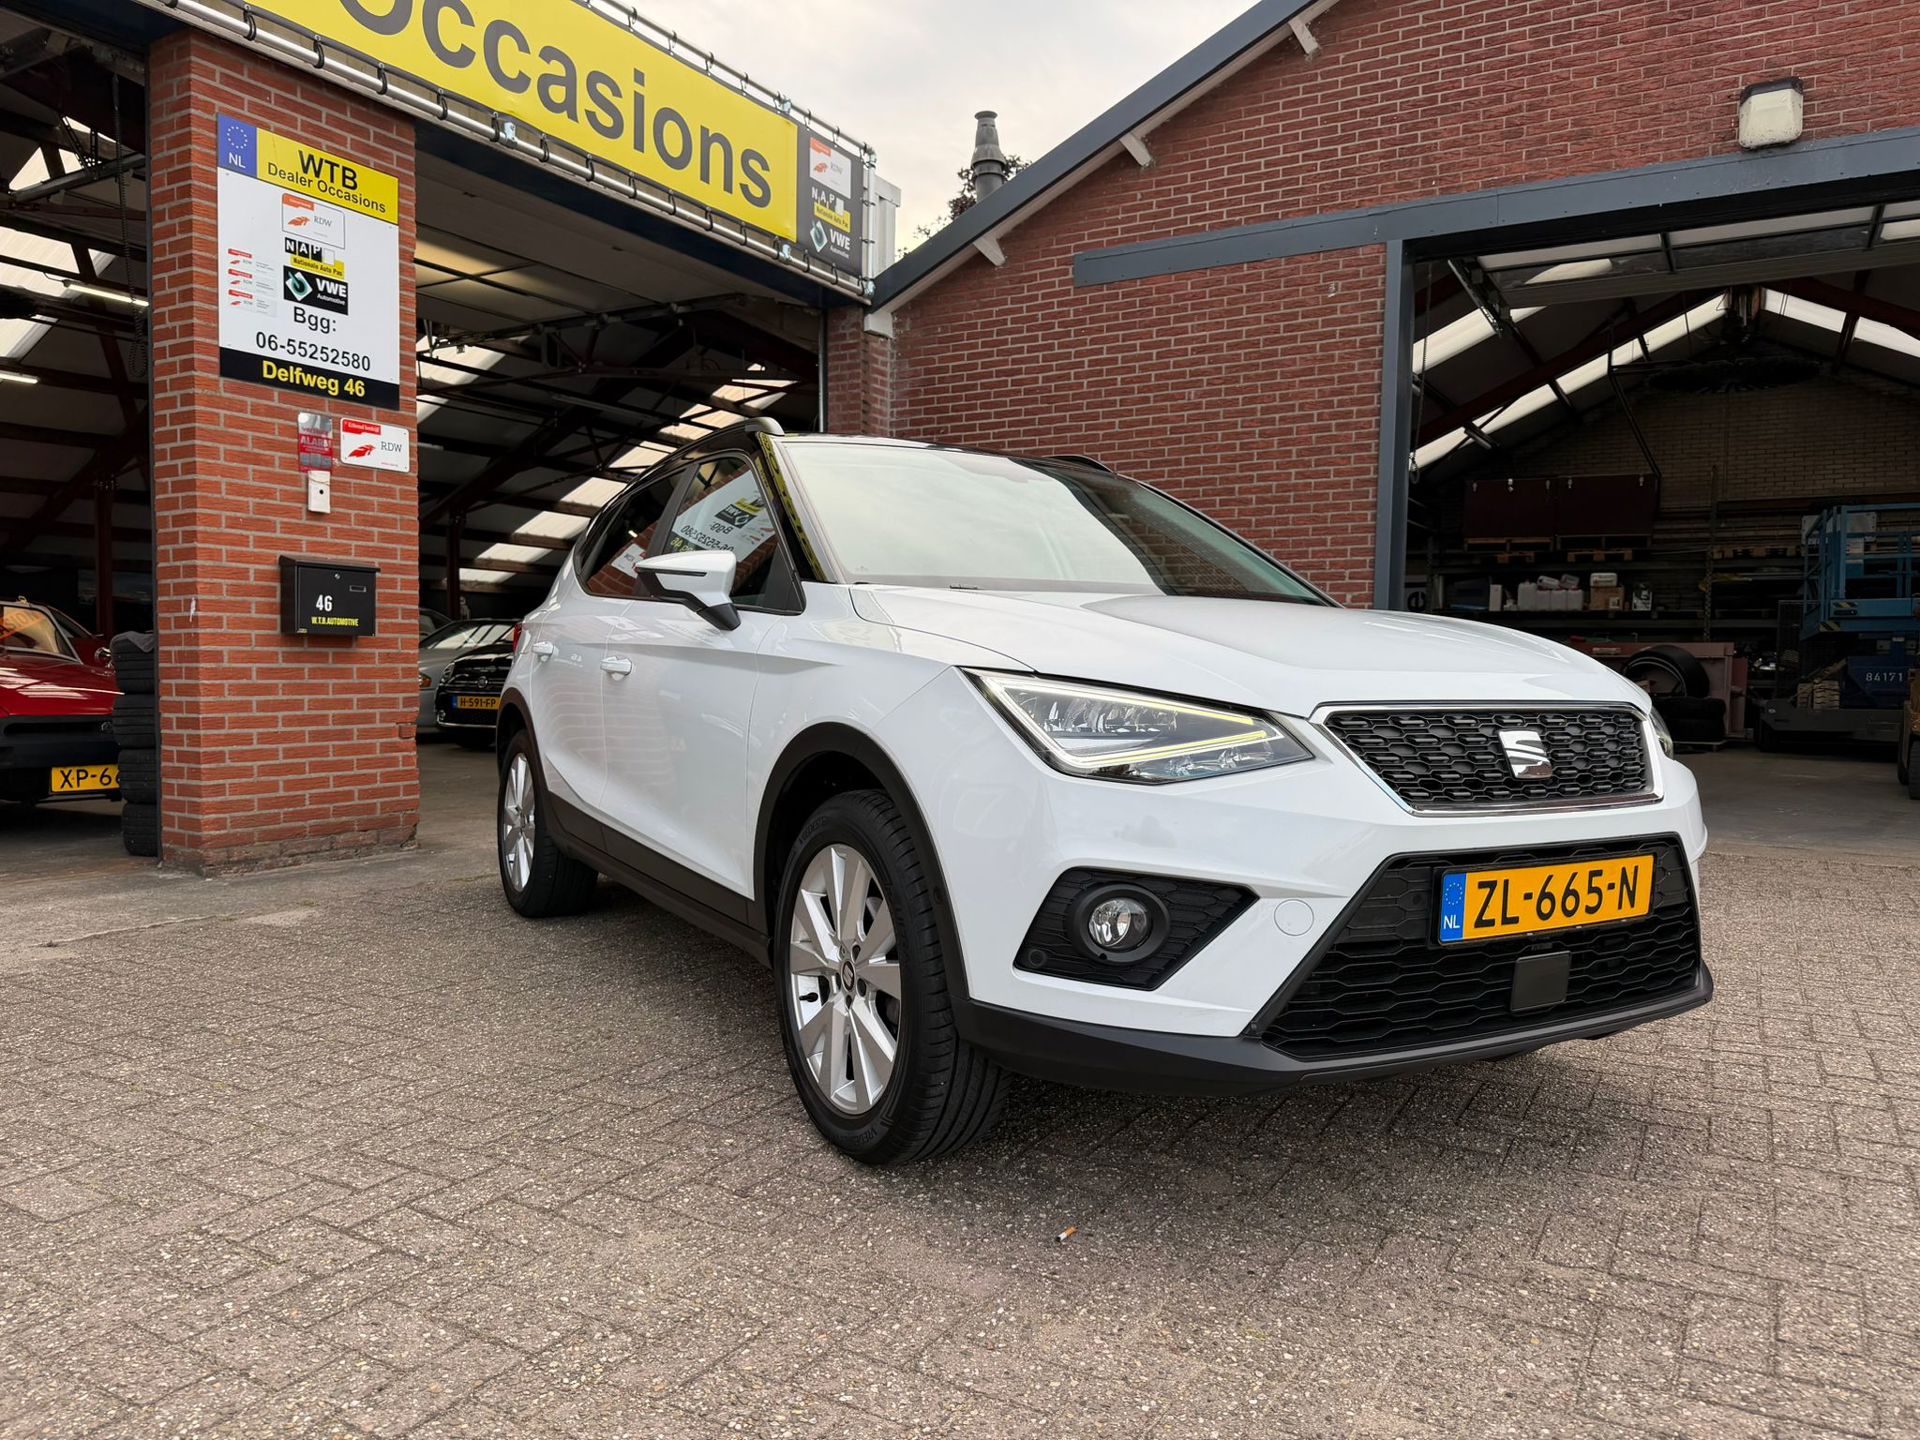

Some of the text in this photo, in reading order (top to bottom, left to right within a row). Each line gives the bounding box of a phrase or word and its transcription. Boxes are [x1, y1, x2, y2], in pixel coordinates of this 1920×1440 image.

[229, 153, 246, 169] NL
[298, 150, 358, 190] WTB
[268, 162, 386, 213] Dealer Occasions
[829, 228, 851, 251] VWE
[315, 277, 347, 298] VWE
[294, 306, 336, 334] Bgg:
[256, 331, 371, 372] 06-55252580
[262, 360, 366, 397] Delfweg 46
[381, 441, 402, 453] RDW
[316, 594, 333, 612] 46
[1865, 672, 1903, 682] 84171
[460, 697, 496, 708] H-591-FP
[60, 767, 120, 789] XP-6
[1474, 865, 1639, 929] ZL-665-N
[1443, 915, 1460, 930] NL
